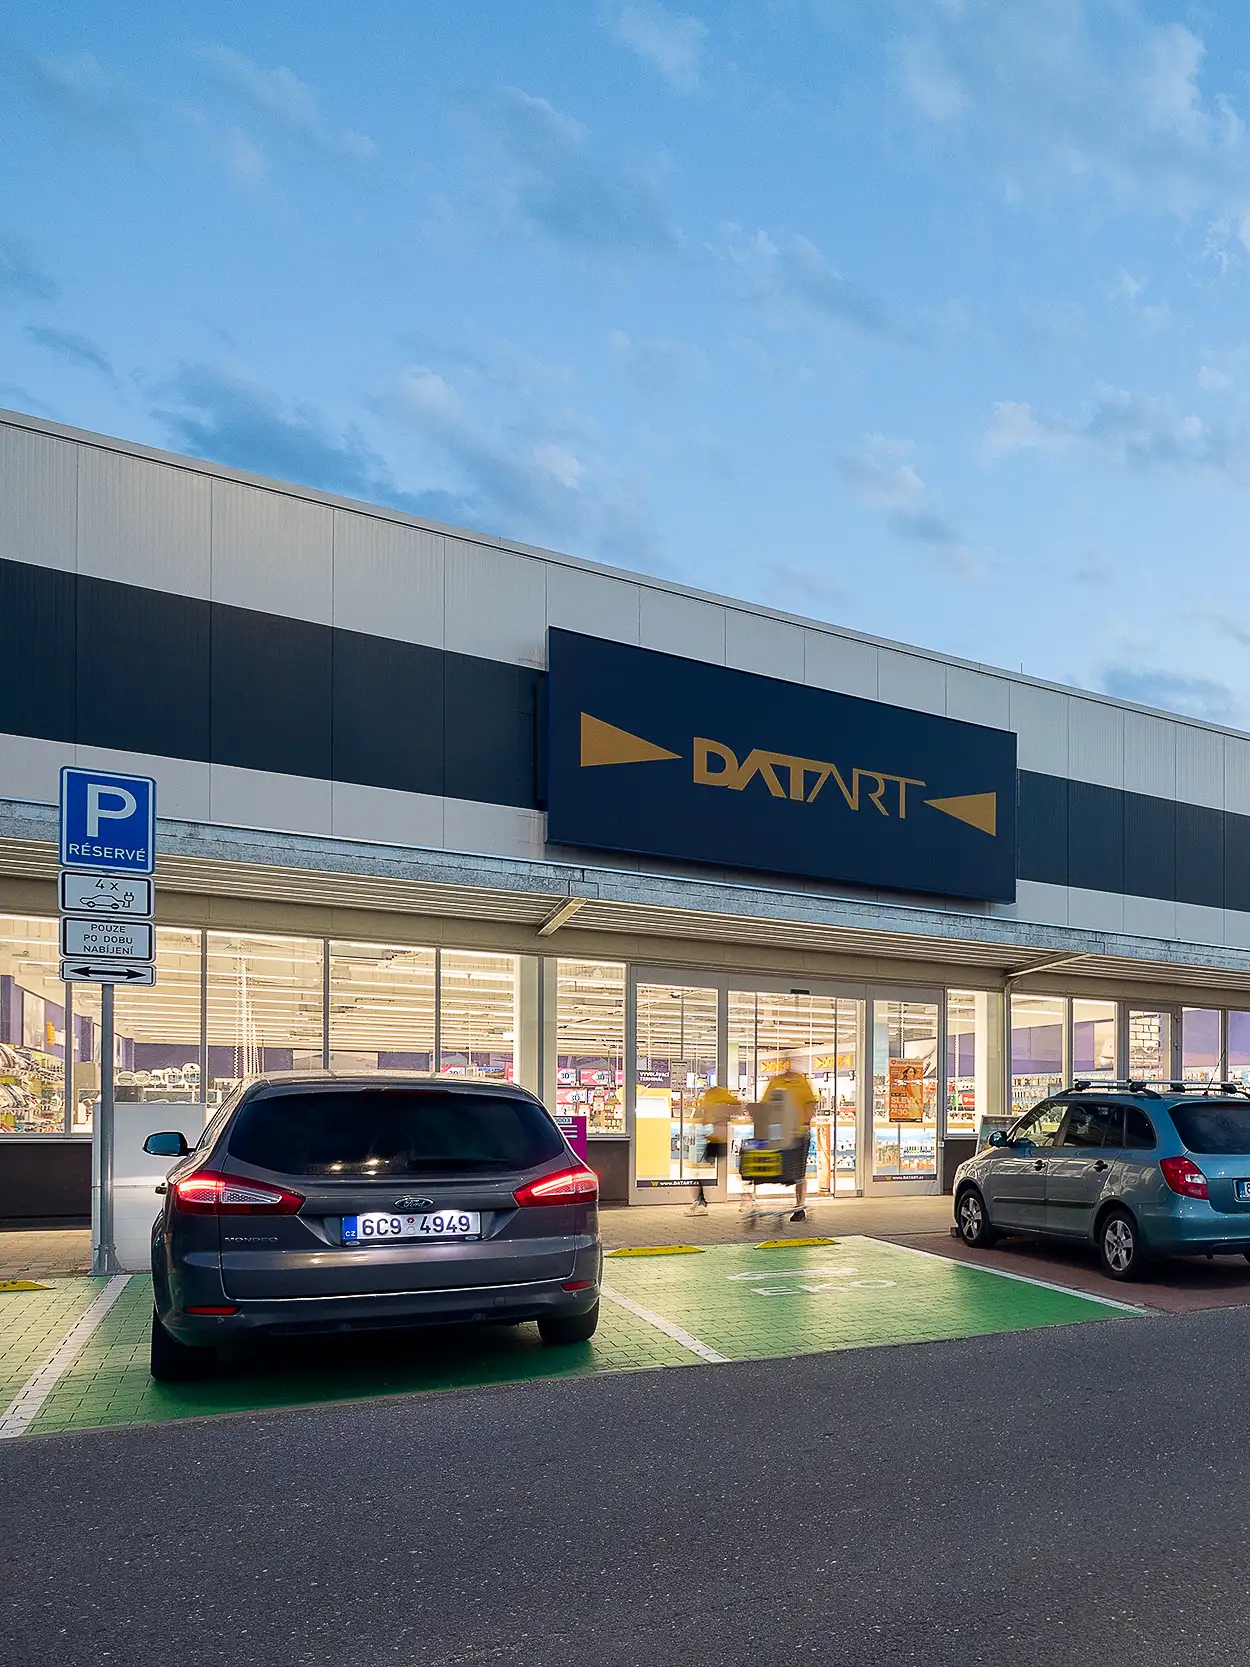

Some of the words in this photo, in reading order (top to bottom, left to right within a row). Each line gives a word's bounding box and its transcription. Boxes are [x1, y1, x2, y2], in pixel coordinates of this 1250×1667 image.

[693, 737, 926, 819] DATART
[86, 783, 137, 838] P
[68, 842, 146, 863] RÉSERVÉ
[95, 879, 104, 890] 4
[90, 923, 126, 934] POUZE
[83, 934, 97, 942] PO
[103, 935, 133, 944] DOBU
[83, 944, 134, 955] NABÍJENÍ
[362, 1217, 402, 1236] 6C9
[419, 1215, 471, 1234] 4949
[750, 1279, 897, 1297] EKO
